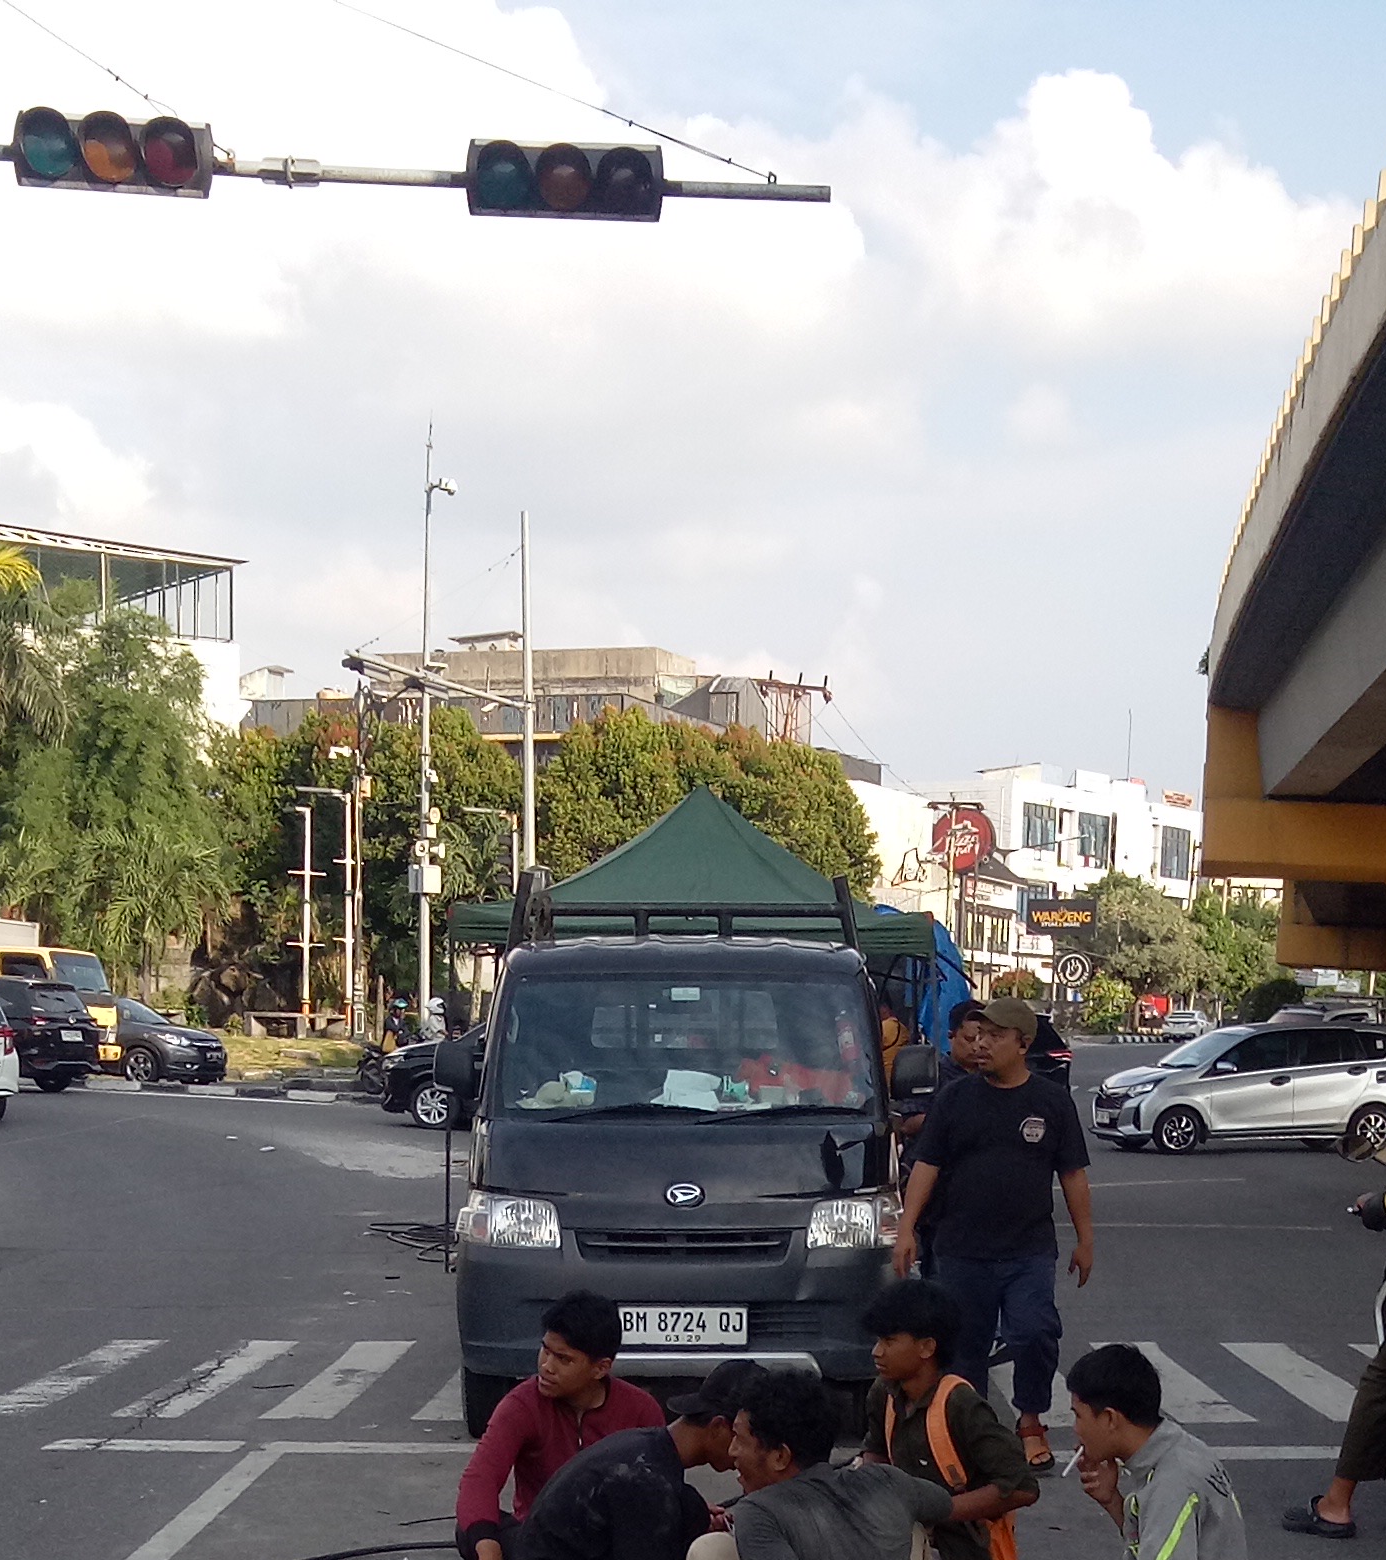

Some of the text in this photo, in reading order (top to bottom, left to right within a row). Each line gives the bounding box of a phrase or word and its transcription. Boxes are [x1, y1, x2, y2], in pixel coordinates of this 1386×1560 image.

[623, 1311, 743, 1332] BM 8724 QJ
